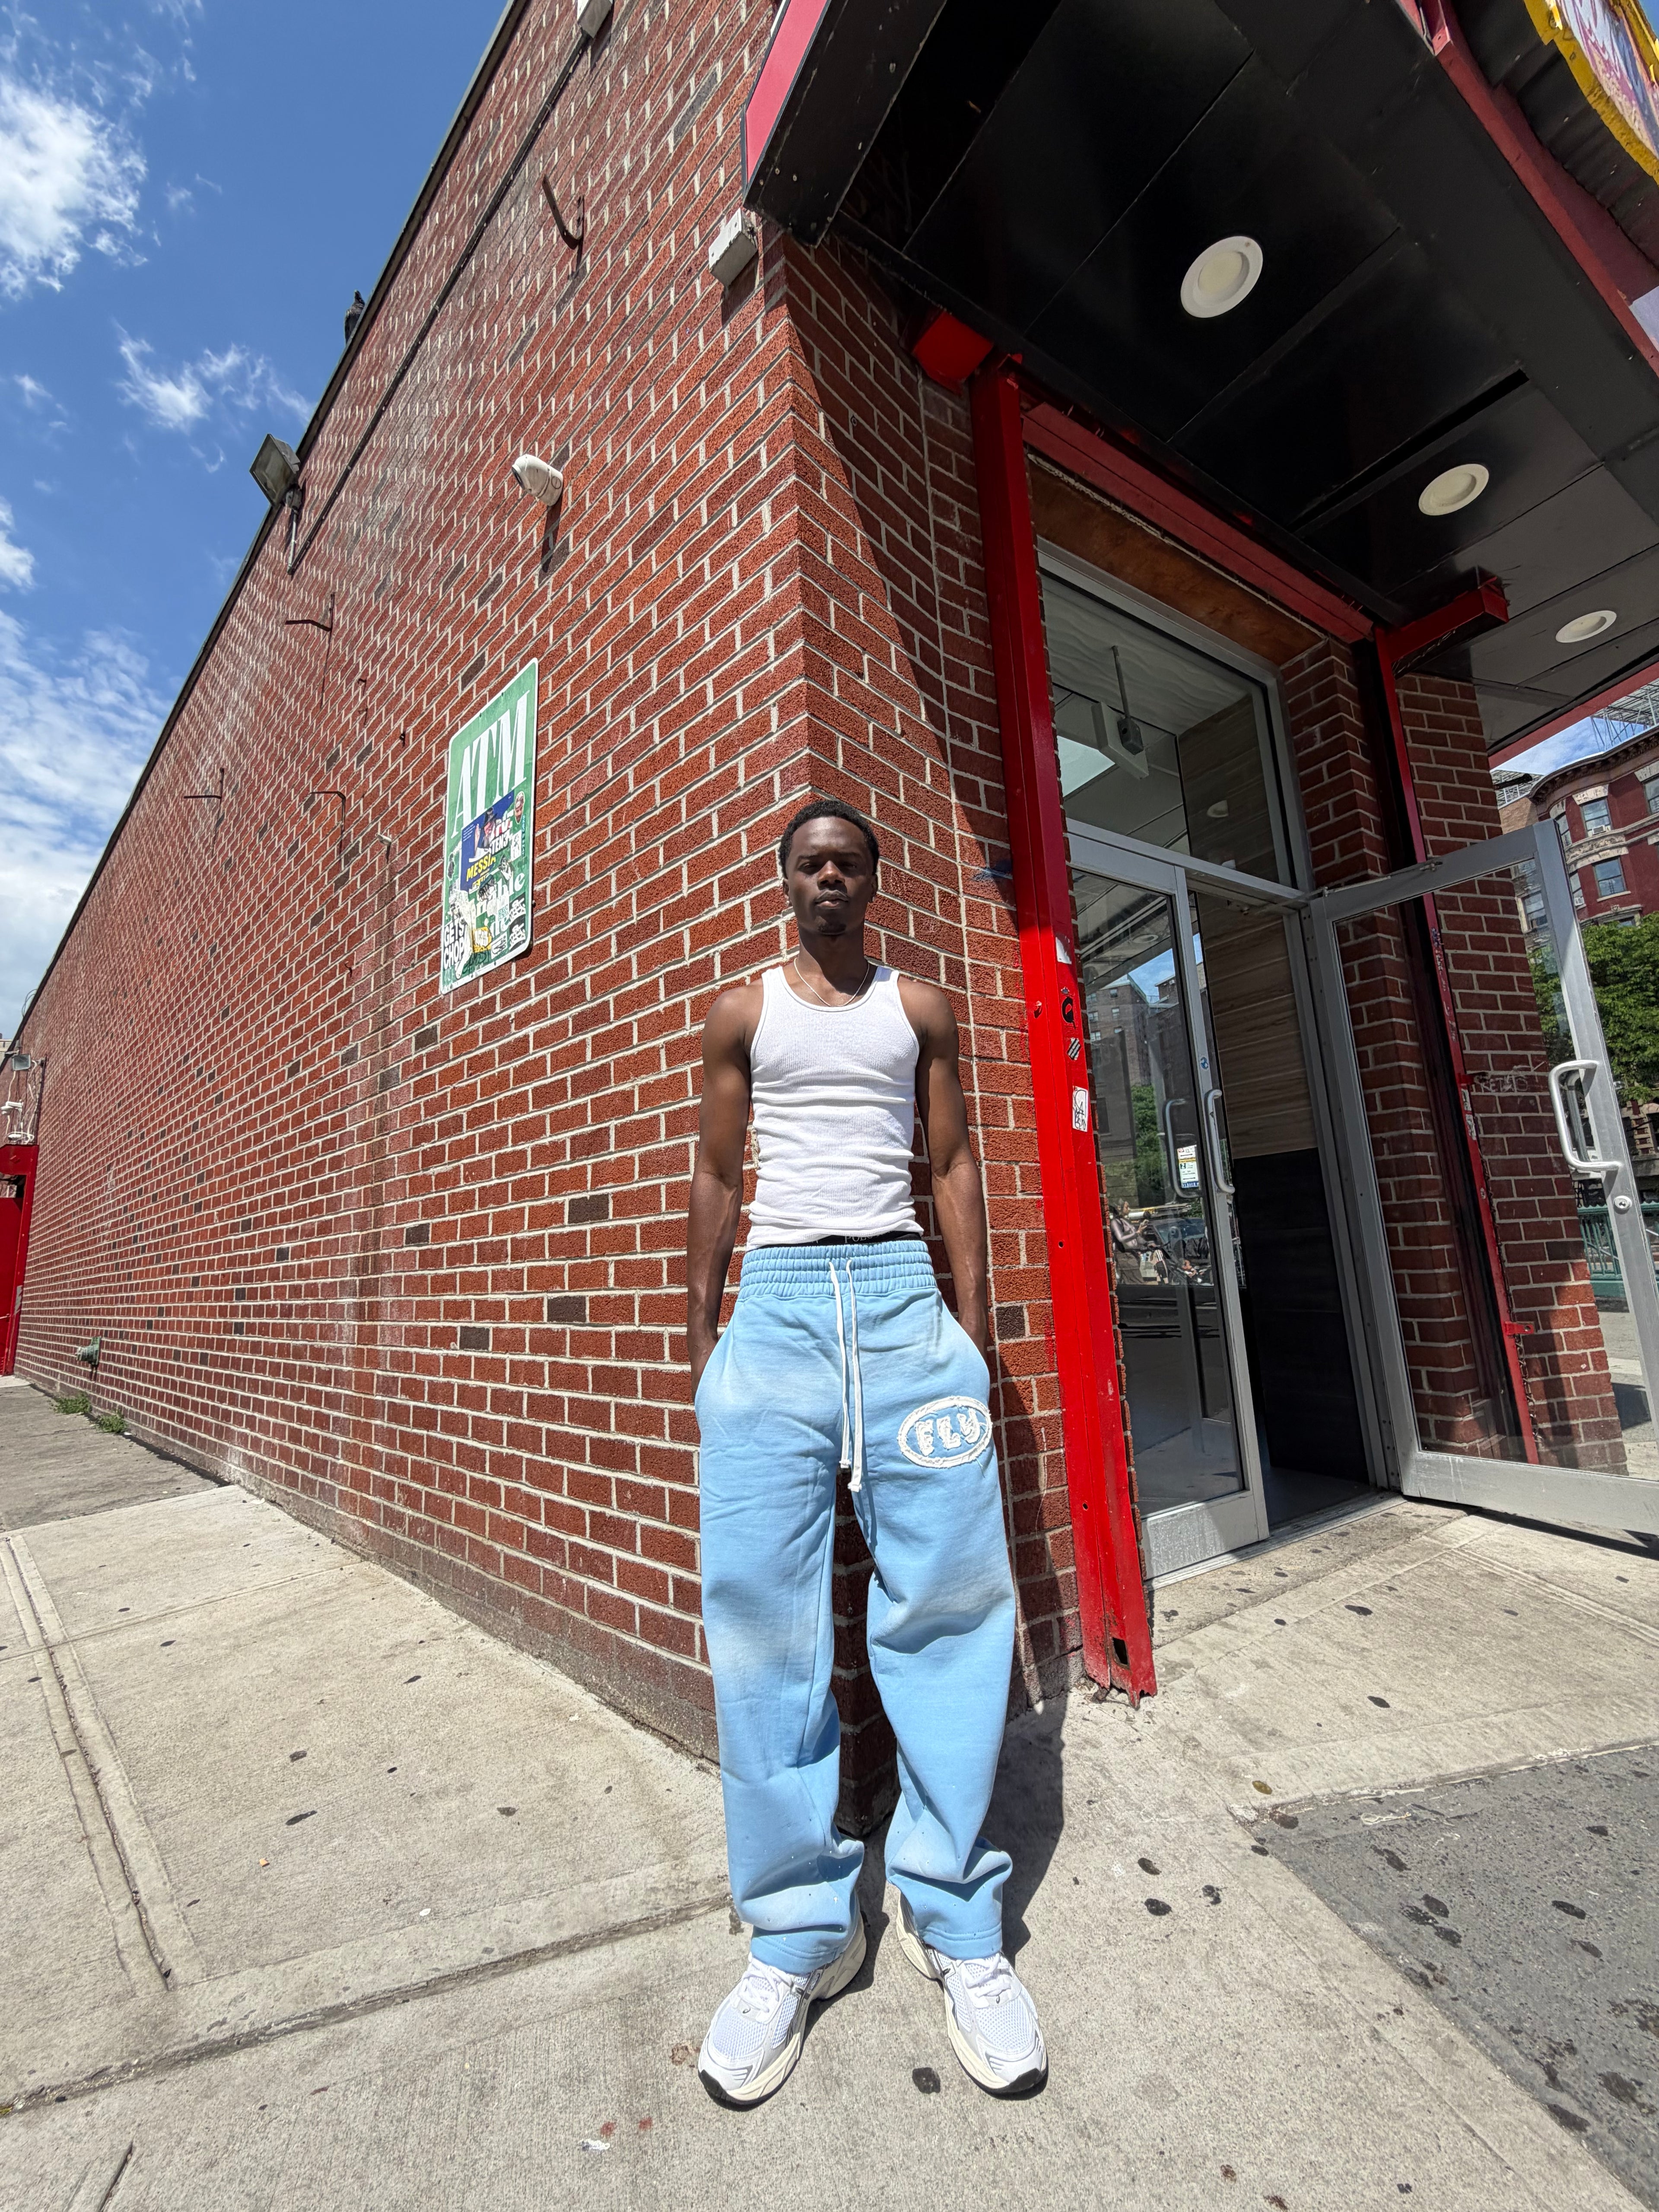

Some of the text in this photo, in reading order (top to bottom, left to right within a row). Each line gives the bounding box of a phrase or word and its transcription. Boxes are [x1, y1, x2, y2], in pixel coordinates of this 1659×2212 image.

[451, 690, 530, 839] ATM
[444, 917, 464, 947] GETS
[914, 1408, 981, 1456] FLY
